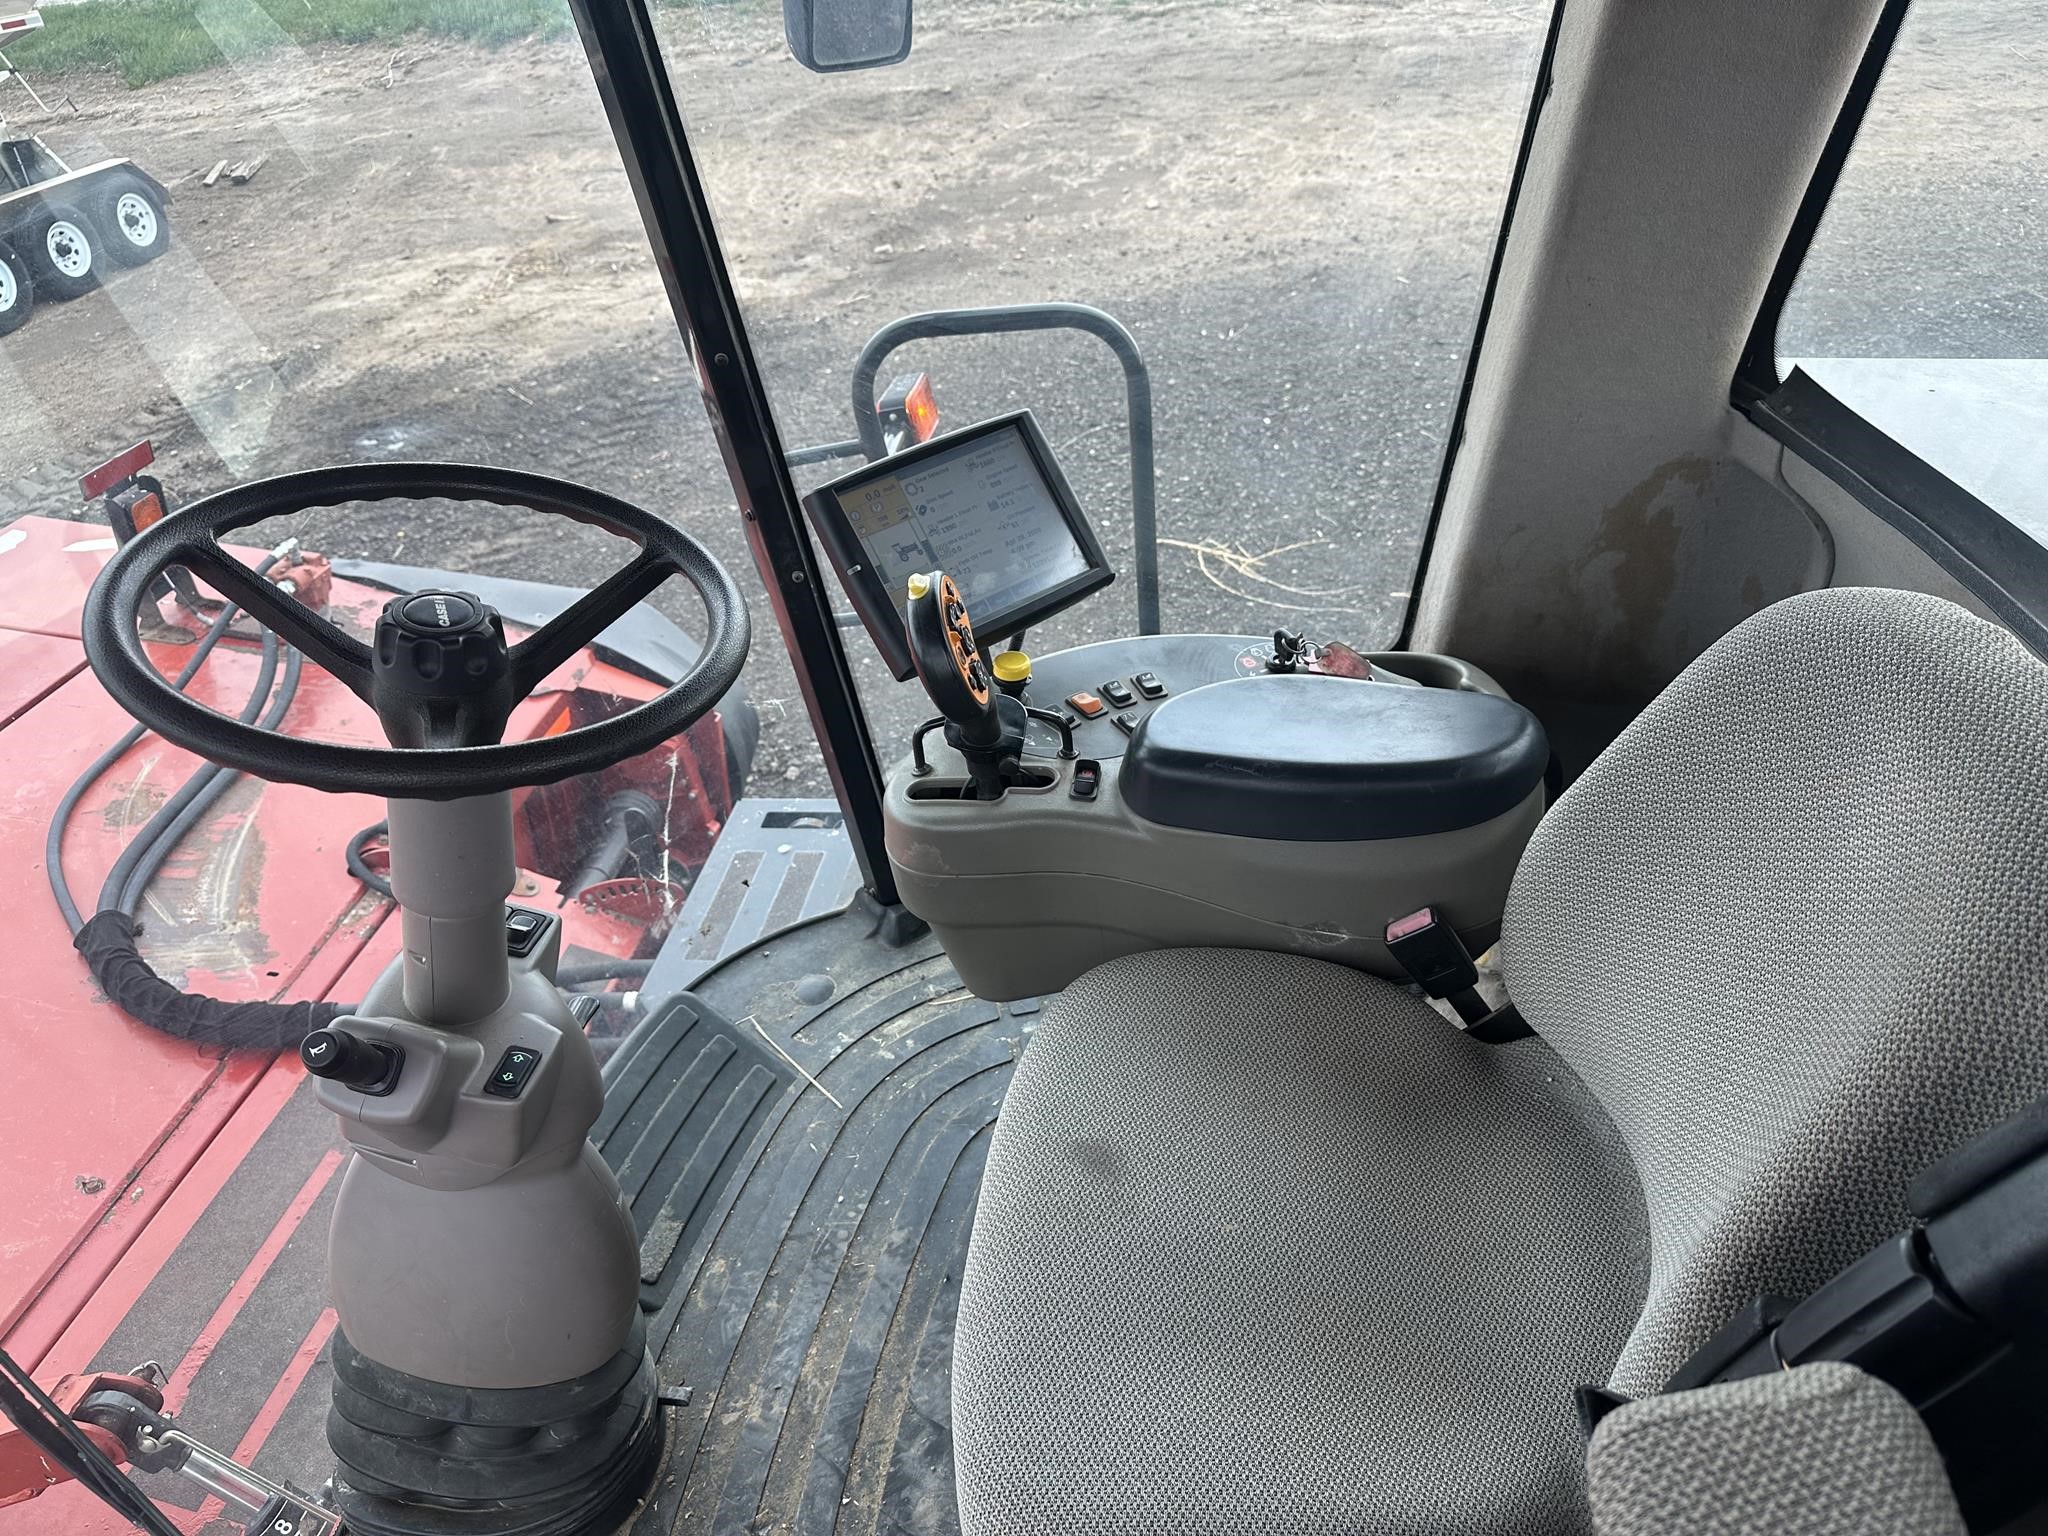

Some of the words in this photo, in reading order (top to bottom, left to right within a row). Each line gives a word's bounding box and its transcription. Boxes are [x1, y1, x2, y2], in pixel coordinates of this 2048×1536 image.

[864, 489, 881, 501] 0.0
[435, 604, 450, 627] CASE
[275, 1519, 292, 1535] 8
